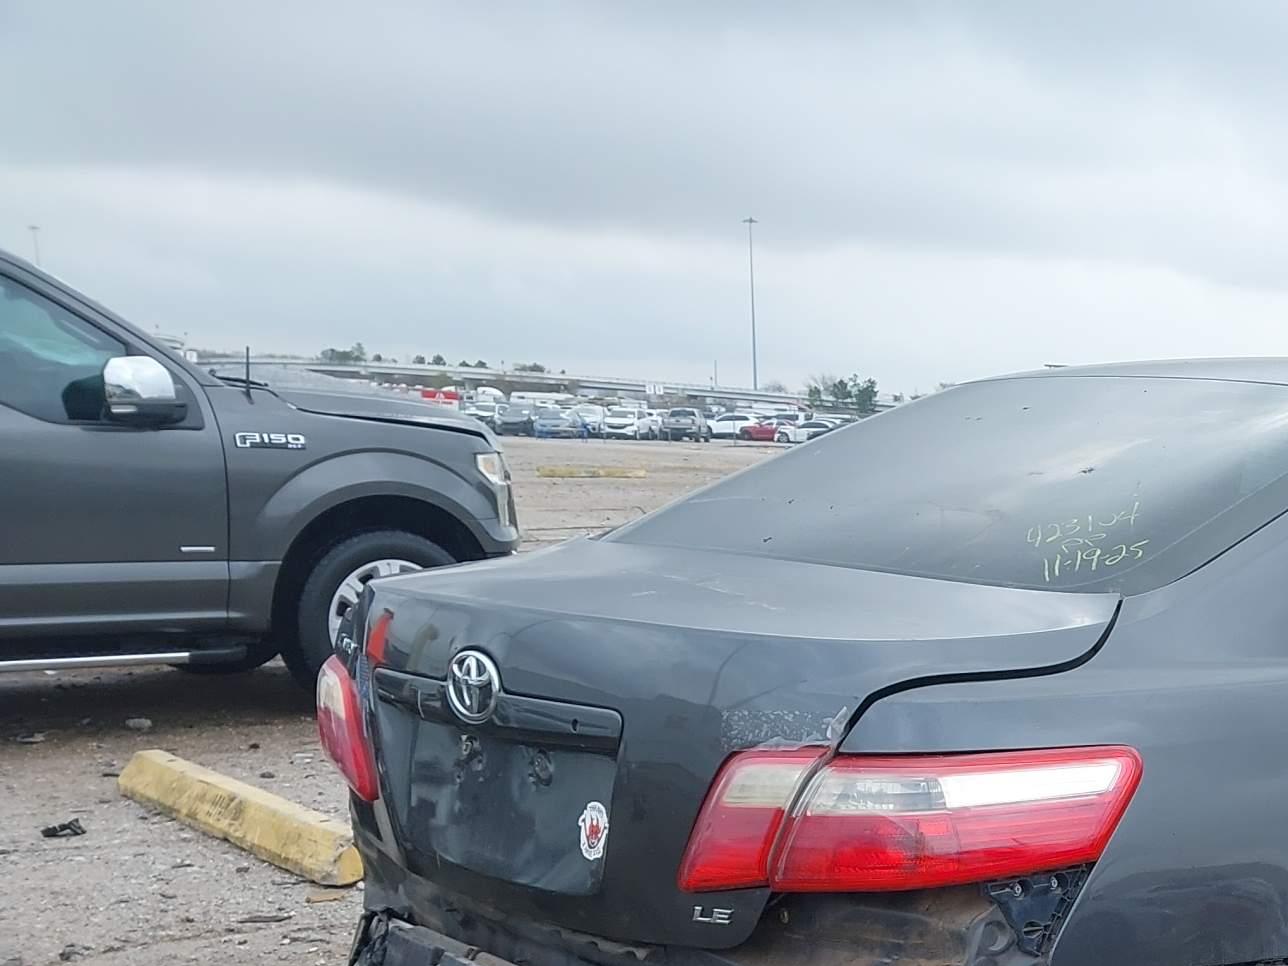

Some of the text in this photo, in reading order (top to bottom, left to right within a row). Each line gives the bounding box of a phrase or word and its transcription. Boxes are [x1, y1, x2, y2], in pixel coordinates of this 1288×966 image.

[235, 432, 305, 448] F150
[1043, 539, 1150, 582] 11-19-25
[692, 906, 735, 924] LE
